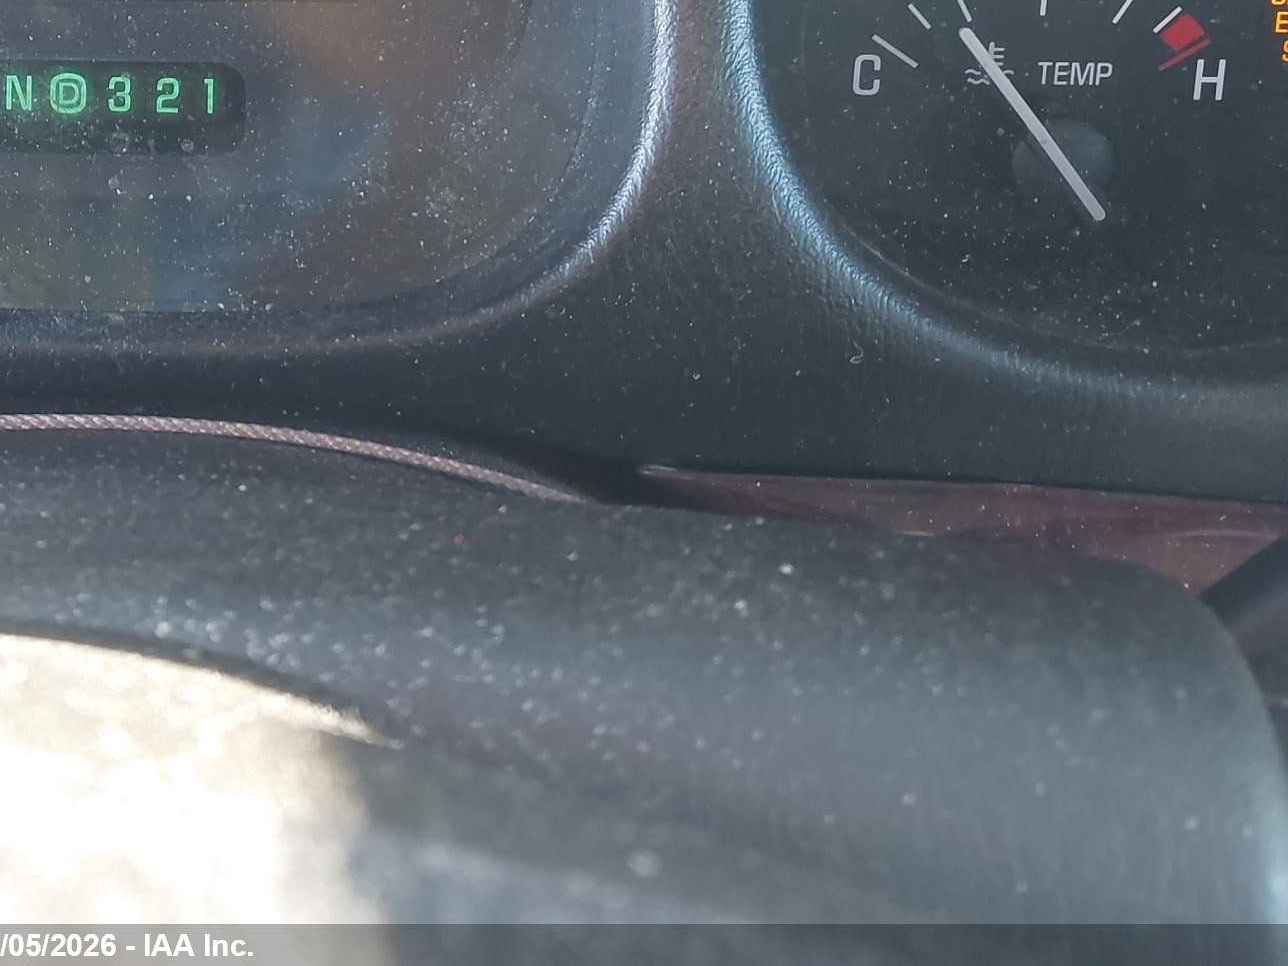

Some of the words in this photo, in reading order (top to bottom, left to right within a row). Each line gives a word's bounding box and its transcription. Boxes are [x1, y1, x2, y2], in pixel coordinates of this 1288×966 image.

[5, 74, 33, 112] N
[107, 76, 133, 113] 3
[155, 77, 181, 114] 2
[203, 78, 216, 114] 1
[852, 54, 882, 96] C
[1037, 61, 1114, 87] TEMP
[1192, 58, 1227, 101] H
